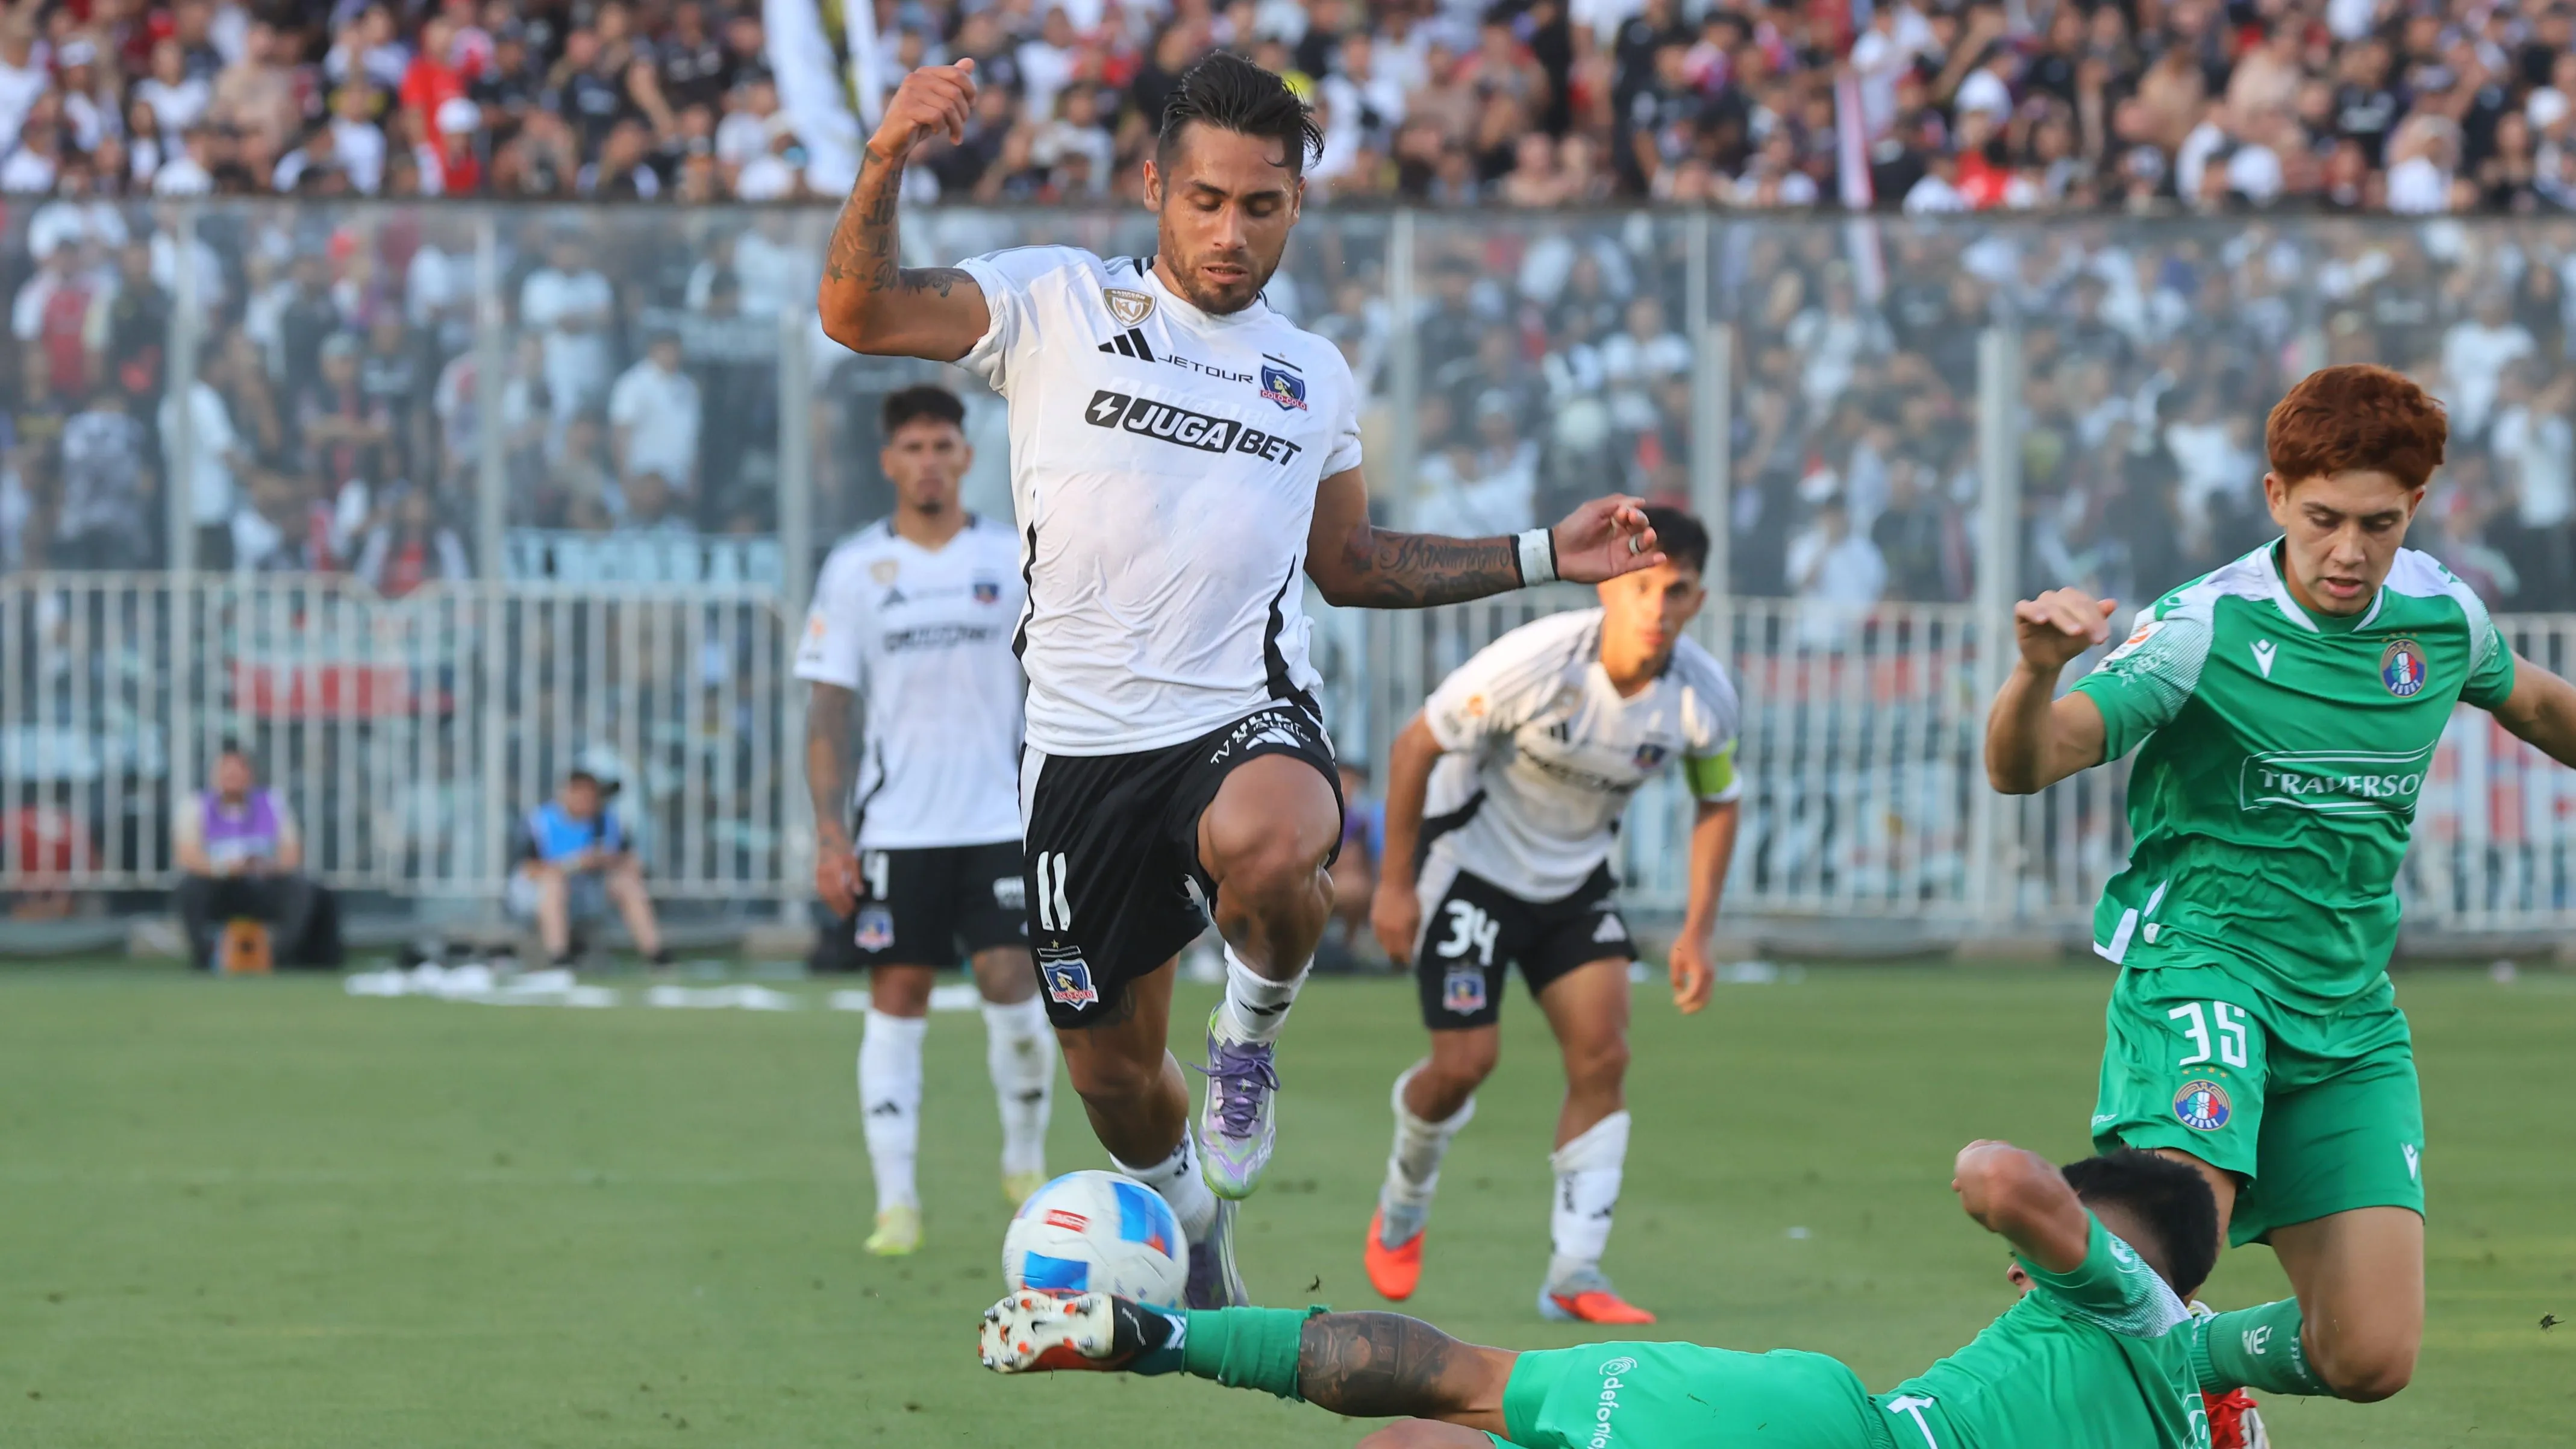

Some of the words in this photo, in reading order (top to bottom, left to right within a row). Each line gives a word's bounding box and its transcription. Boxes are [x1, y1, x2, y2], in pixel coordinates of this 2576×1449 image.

[1158, 354, 1254, 384] JETOUR
[1210, 739, 1230, 764] TV
[2257, 768, 2421, 797] TRAVERSO
[1037, 851, 1071, 931] 11
[1436, 899, 1500, 966] 34
[2168, 1000, 2248, 1069] 35
[1587, 1377, 1624, 1449] defonta
